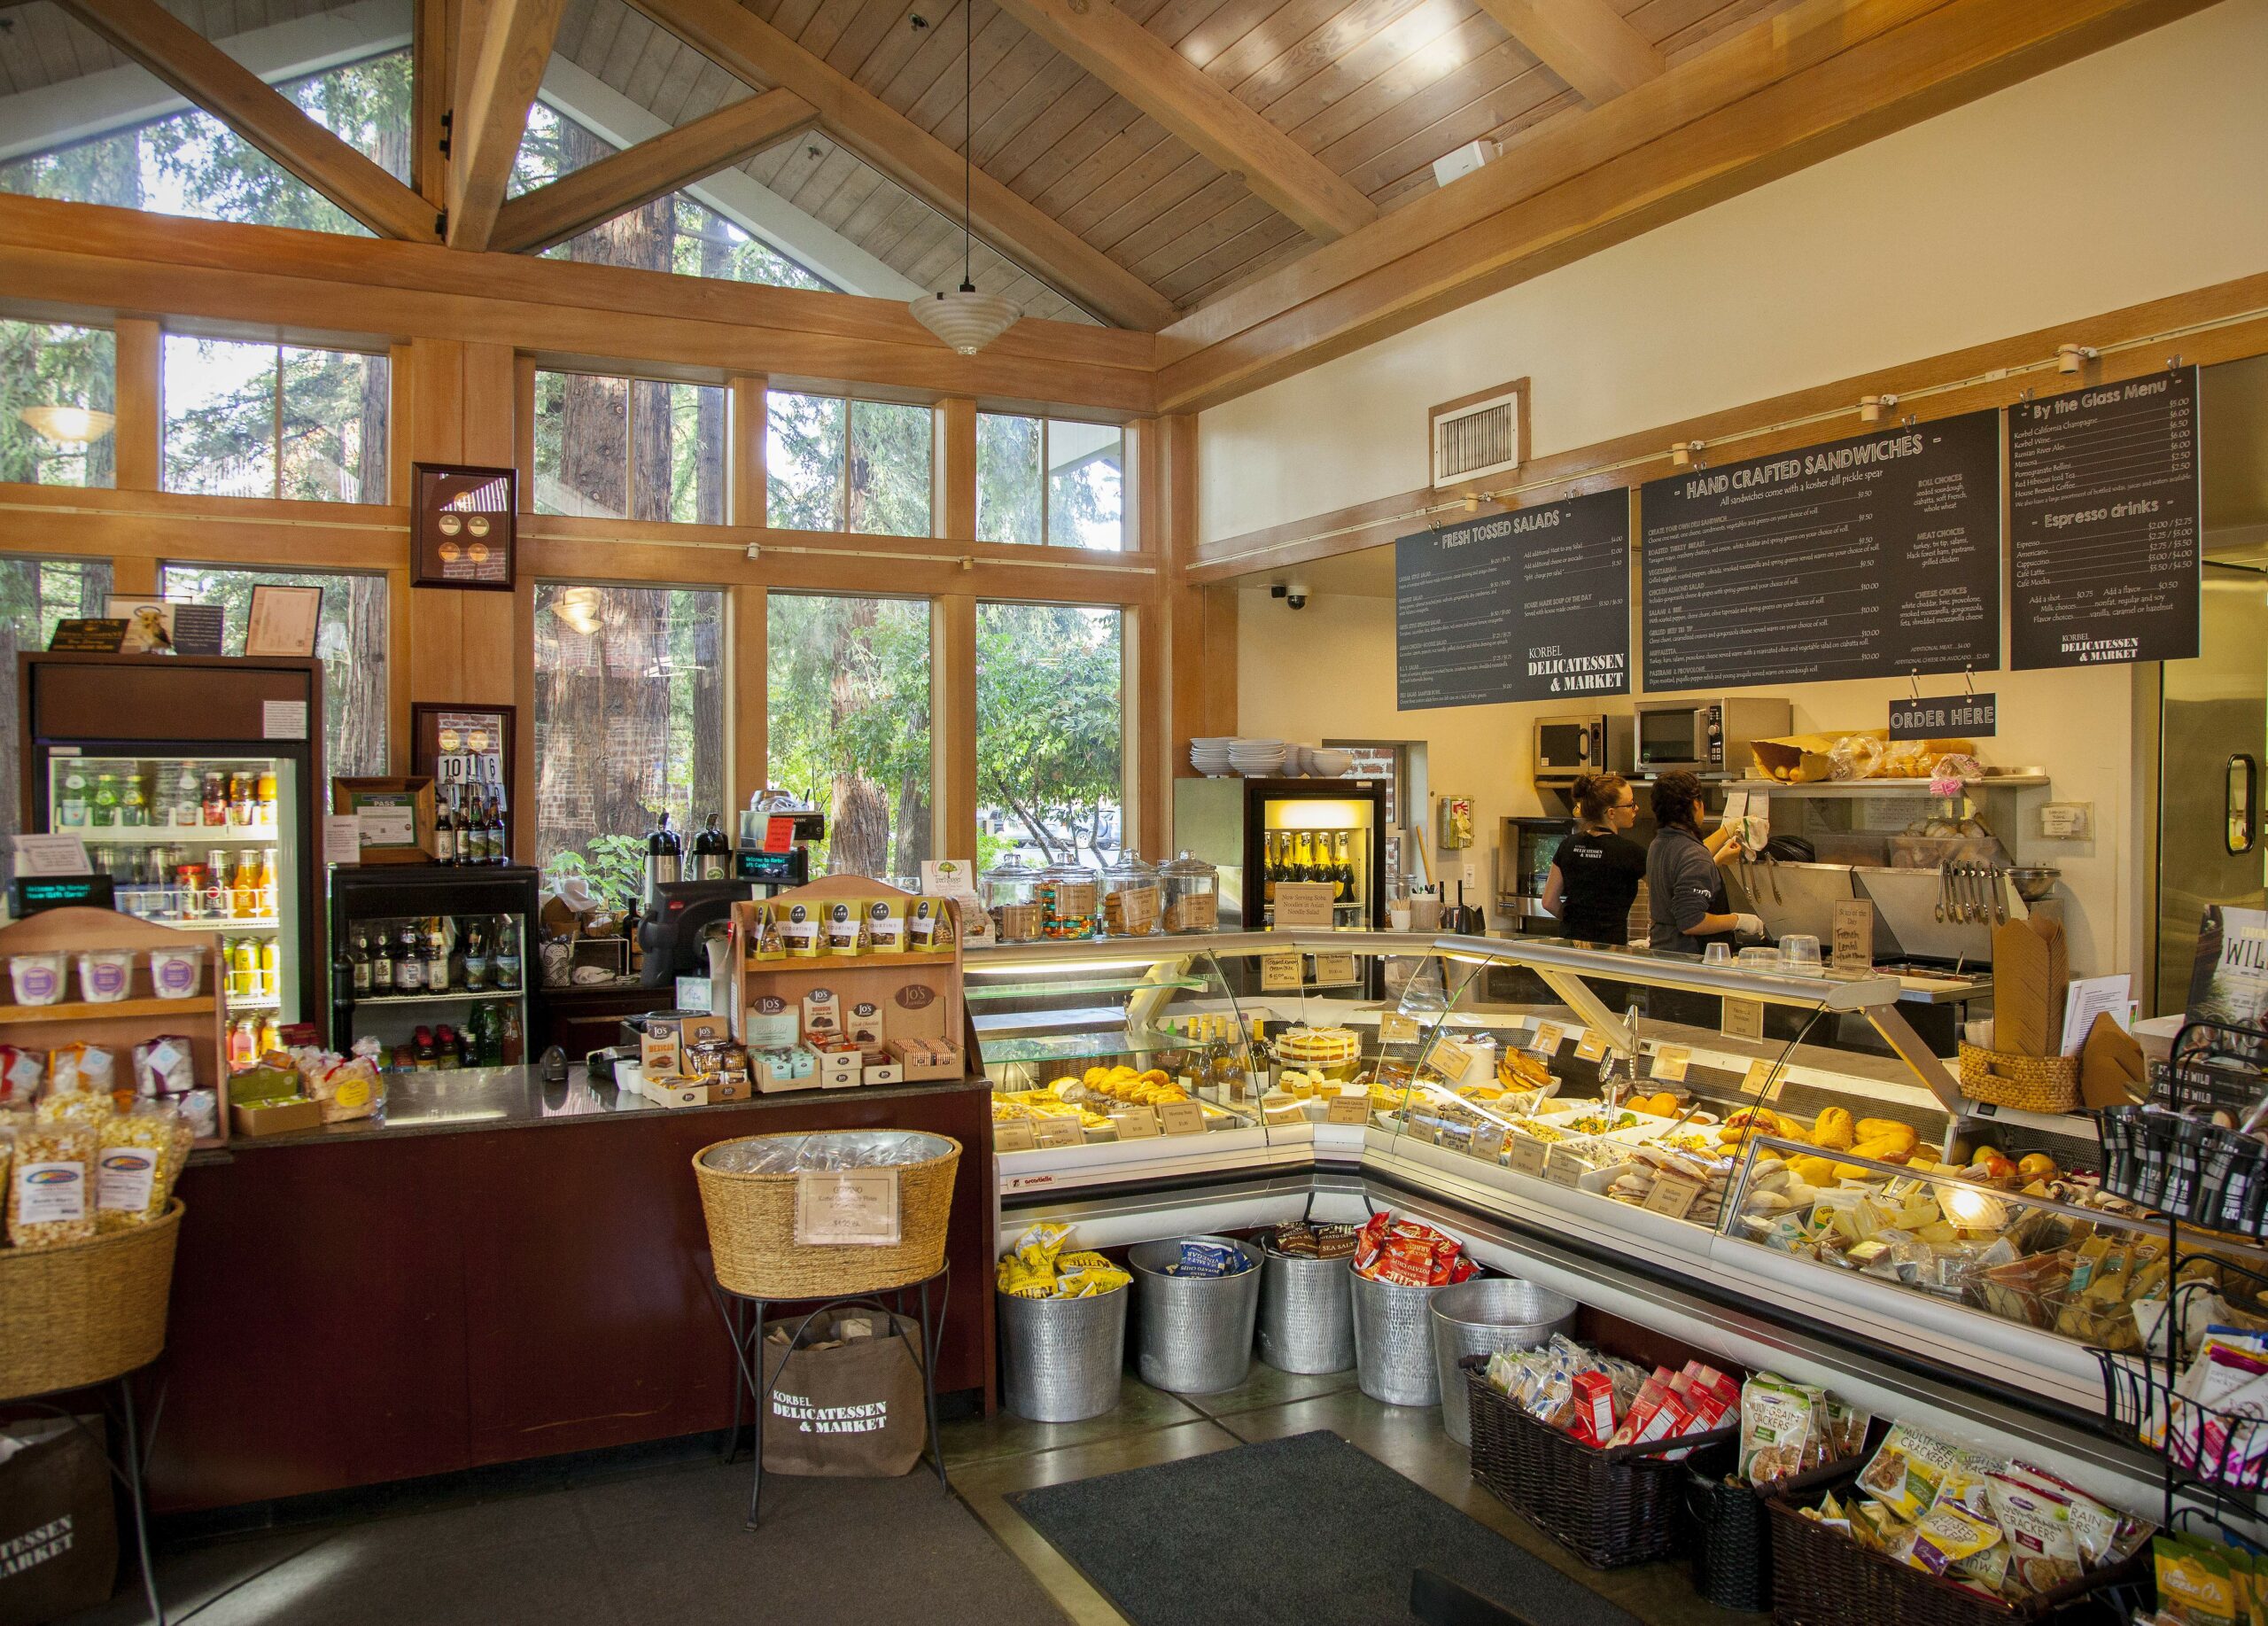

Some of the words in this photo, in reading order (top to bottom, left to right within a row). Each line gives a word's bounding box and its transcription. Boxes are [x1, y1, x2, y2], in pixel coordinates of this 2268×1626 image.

[2033, 405, 2051, 419] By
[2054, 400, 2078, 414] the
[2081, 391, 2121, 408] Glass
[2124, 380, 2167, 400] Menu
[2015, 428, 2032, 439] Korbel
[2034, 424, 2062, 435] California
[2062, 418, 2098, 430] Champagne
[2170, 397, 2189, 408] $5.00
[2015, 439, 2032, 448] Korbel
[2170, 408, 2189, 419] $6.00
[2015, 449, 2035, 458] Russian
[2170, 419, 2188, 430] $6.50
[2171, 430, 2190, 440] $6.00
[1686, 475, 1728, 499] HAND
[1732, 459, 1801, 489] CRAFTED
[1805, 433, 1923, 476] SANDWICHES
[2016, 467, 2052, 478] Pomegranate
[2171, 440, 2190, 451] $6.00
[2016, 479, 2025, 488] Red
[2171, 451, 2190, 462] $2.50
[2034, 485, 2054, 494] Brewed
[2055, 481, 2076, 491] Coffee
[2171, 462, 2190, 472] $2.50
[1720, 495, 1729, 507] All
[1730, 490, 1764, 505] sandwiches
[1765, 488, 1783, 497] come
[1784, 485, 1798, 494] with
[1806, 478, 1829, 490] kosher
[1829, 474, 1841, 486] dill
[1842, 471, 1863, 486] pickle
[1864, 470, 1884, 482] spear
[1918, 478, 1933, 487] ROLL
[1934, 473, 1962, 484] CHOICES
[1936, 494, 1946, 502] soft
[2045, 508, 2108, 529] Espresso
[2111, 499, 2159, 517] drinks
[2148, 520, 2168, 531] $2.00
[2175, 517, 2193, 527] $2.75
[1441, 529, 1471, 549] FRESH
[1472, 520, 1511, 542] TOSSED
[1513, 510, 1560, 534] SALADS
[1916, 532, 1935, 541] MEAT
[1936, 527, 1965, 538] CHOICES
[2016, 549, 2048, 558] Americano
[2148, 532, 2166, 541] $2.25
[2016, 559, 2050, 569] Cappuccino
[2149, 541, 2167, 552] $2.75
[2016, 569, 2029, 578] Café
[2172, 549, 2193, 560] $4.00
[2016, 579, 2029, 587] Café
[2031, 577, 2050, 586] Mocha
[2173, 560, 2193, 571] $4.50
[1915, 589, 1938, 599] CHEESE
[1938, 587, 1967, 596] CHOICES
[2094, 596, 2117, 607] nonfat,
[2118, 595, 2140, 606] regular
[2090, 609, 2110, 618] vanilla,
[2112, 605, 2136, 616] caramel
[2146, 603, 2174, 612] hazelnut
[2061, 637, 2139, 653] DELICATESSEN
[2062, 632, 2090, 642] KORBEL
[1529, 645, 1563, 659] KORBEL
[2079, 653, 2088, 662] &
[2090, 649, 2139, 661] MARKET
[1527, 653, 1624, 676] DELICATESSEN
[1550, 677, 1561, 692] &
[1564, 672, 1624, 691] MARKET
[1891, 710, 1946, 729] ORDER
[1951, 706, 1994, 726] HERE
[444, 759, 462, 777] 10
[2225, 937, 2268, 969] WIL
[815, 990, 827, 1001] Jo's
[905, 986, 926, 1006] Jo's
[763, 999, 780, 1013] Jo's
[858, 1005, 872, 1015] Jo's
[654, 1026, 667, 1038] Jo's
[2191, 1071, 2210, 1085] WILD
[2192, 1090, 2211, 1104] WILD
[1408, 1264, 1430, 1275] POTATO
[773, 1389, 812, 1407] KORBEL
[773, 1401, 886, 1420] DELICATESSEN
[1749, 1401, 1799, 1423] MULTI-GRAIN
[799, 1421, 812, 1432] &
[815, 1416, 887, 1434] MARKET
[1900, 1437, 1950, 1470] CRACKERS
[0, 1514, 73, 1560] TESSEN
[2003, 1513, 2056, 1543] CRACKERS
